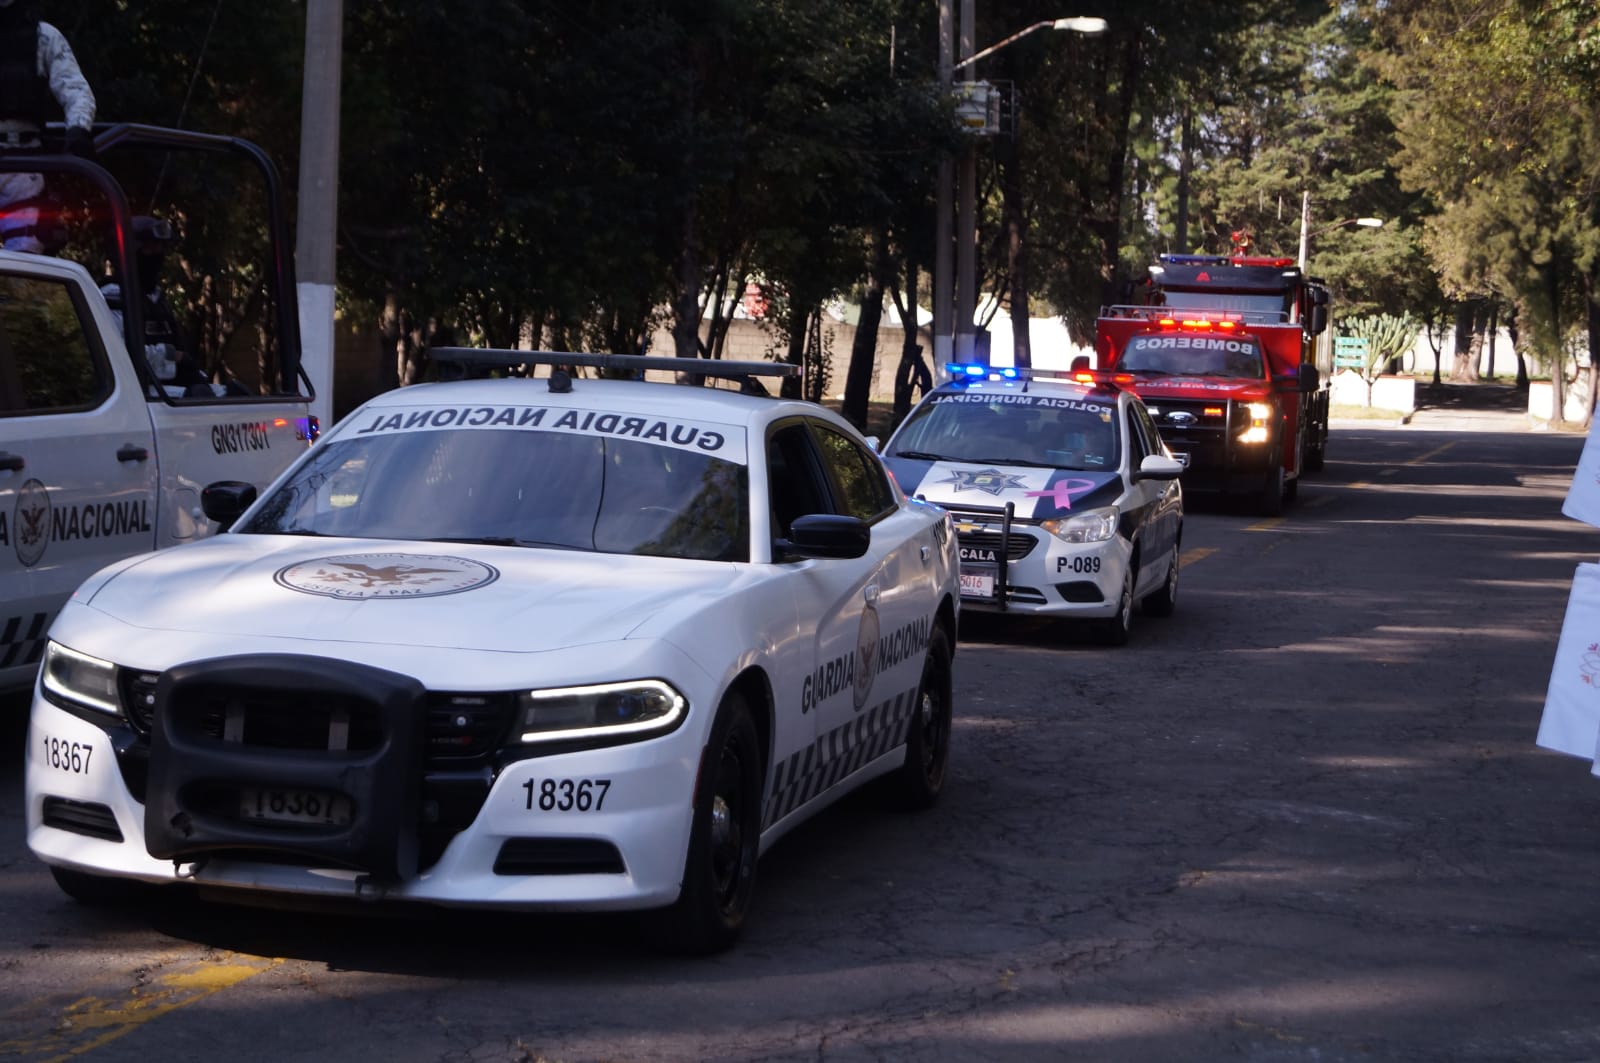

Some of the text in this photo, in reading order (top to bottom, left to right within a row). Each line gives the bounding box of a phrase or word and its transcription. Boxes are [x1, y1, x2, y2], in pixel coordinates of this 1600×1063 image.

[211, 421, 270, 455] GN317301
[52, 499, 151, 542] NACIONAL
[1057, 556, 1101, 573] P-089
[300, 583, 365, 597] USTICIA
[801, 614, 930, 715] GUARDIA NACIONAL
[43, 734, 93, 776] 18367
[522, 778, 612, 812] 18367
